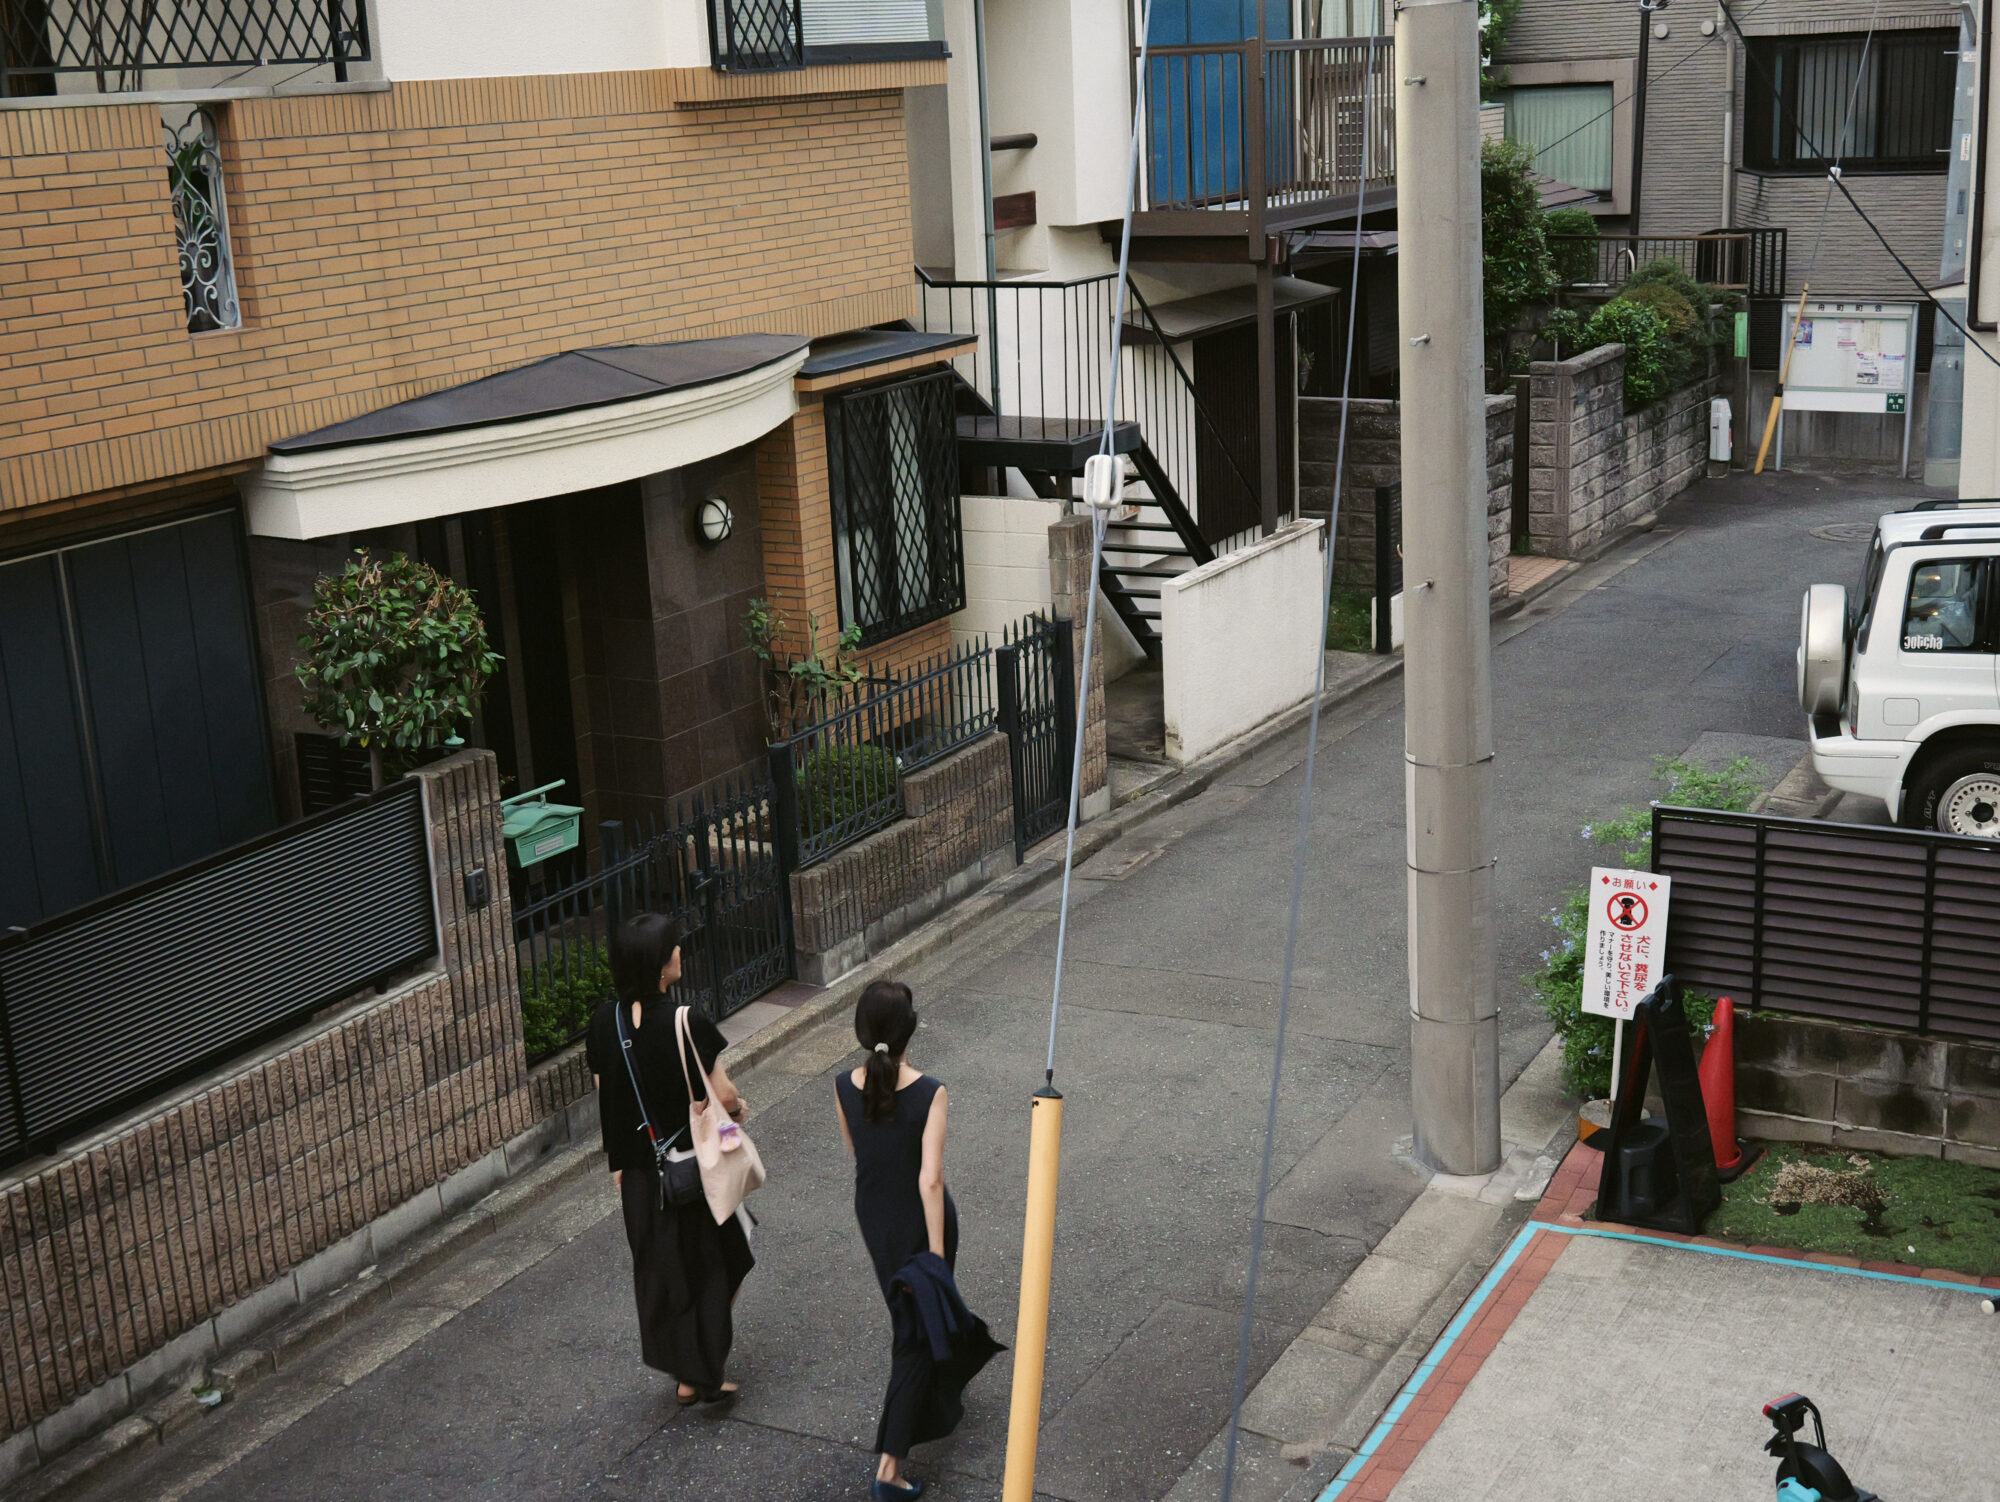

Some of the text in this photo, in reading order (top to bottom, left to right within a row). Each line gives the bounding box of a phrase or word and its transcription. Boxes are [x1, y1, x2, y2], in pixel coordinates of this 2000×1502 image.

[1612, 877, 1647, 889] お願い
[1615, 934, 1633, 1012] させないで下さい。
